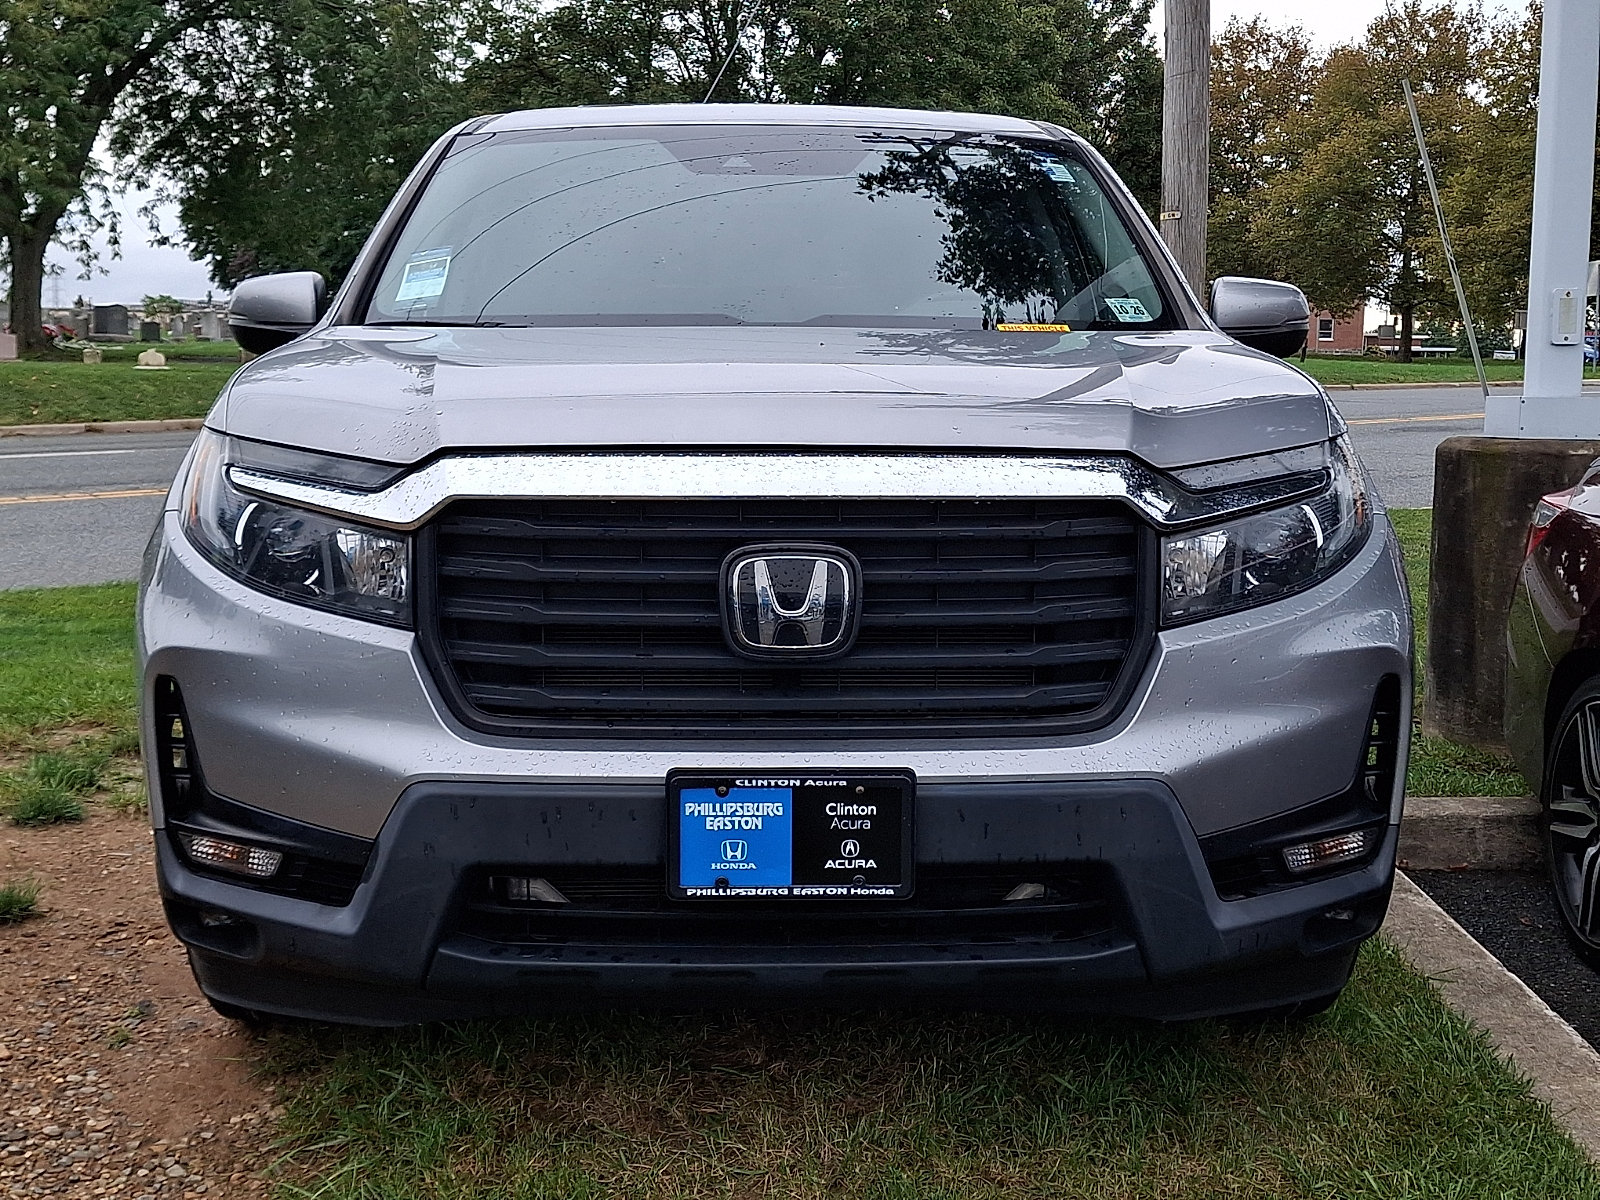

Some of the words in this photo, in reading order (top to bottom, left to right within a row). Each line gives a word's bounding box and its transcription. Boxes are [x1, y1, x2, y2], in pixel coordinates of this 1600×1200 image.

[1114, 305, 1129, 315] 10
[1131, 306, 1145, 315] 26
[684, 803, 783, 817] PHILLIPSBURG
[825, 803, 877, 816] Clinton
[705, 817, 763, 831] EASTON
[830, 817, 871, 830] Acura
[824, 859, 877, 869] ACURA
[686, 888, 789, 896] PHILLIPSBURG
